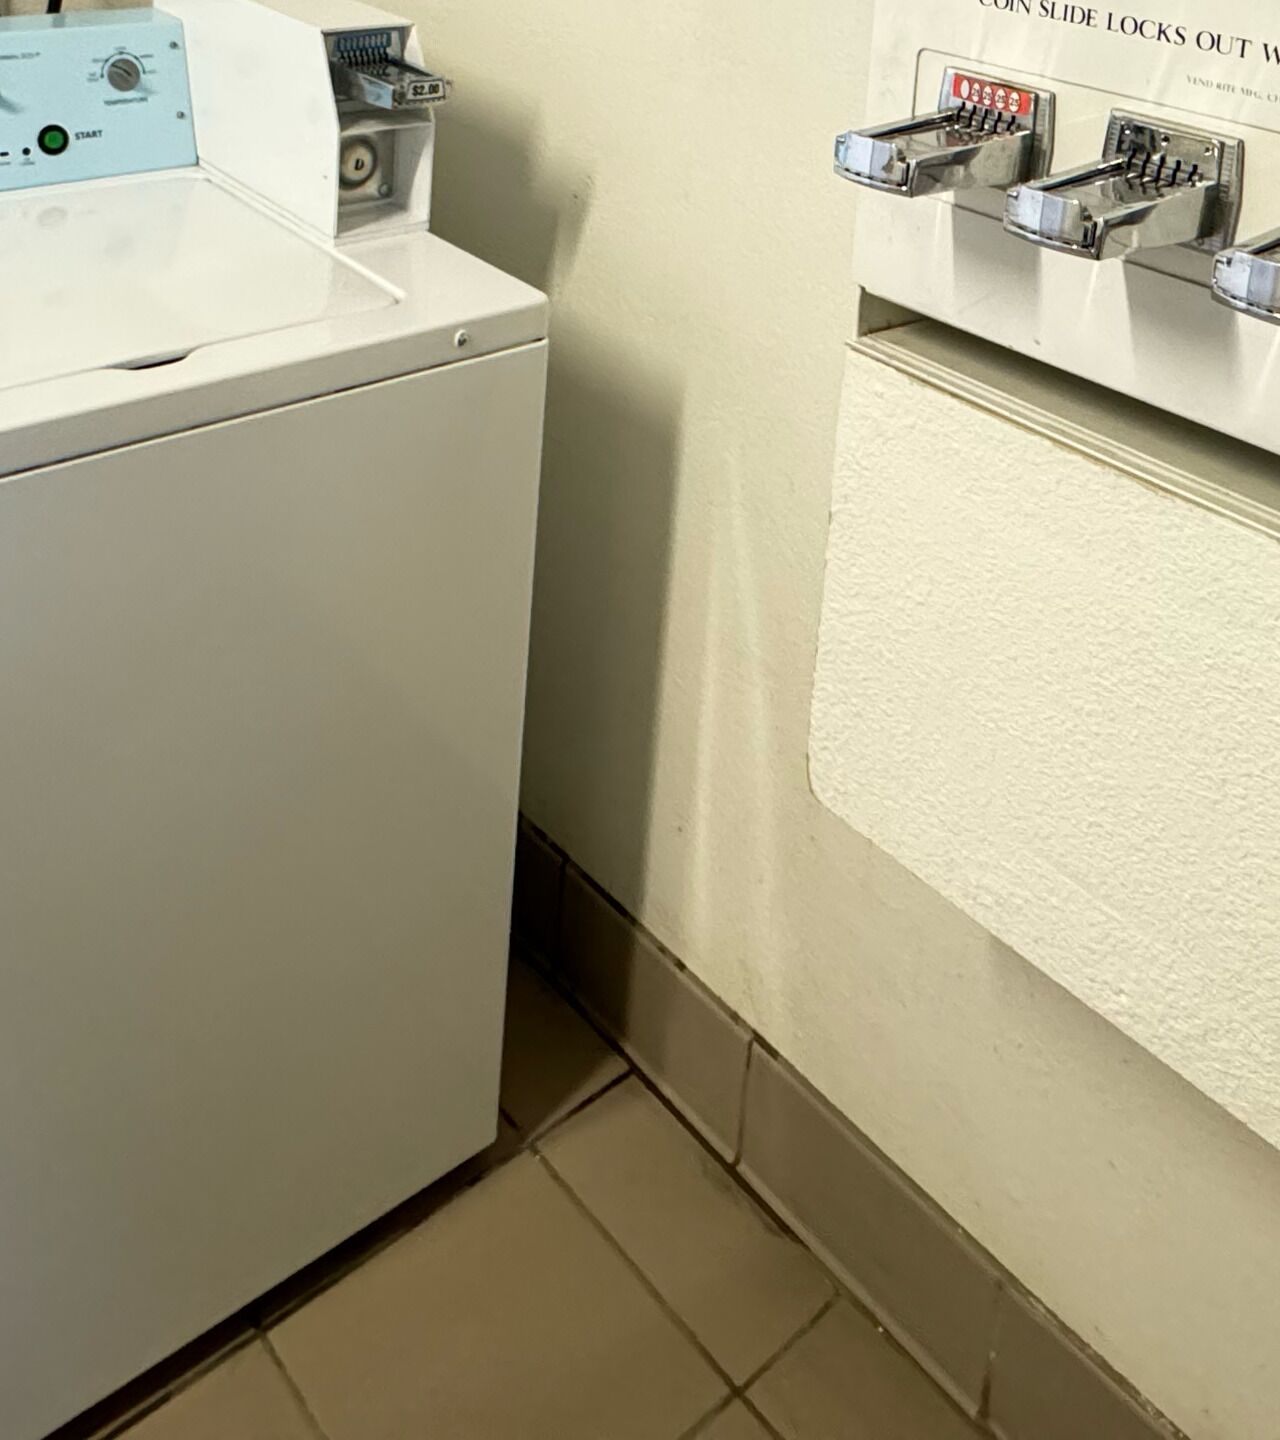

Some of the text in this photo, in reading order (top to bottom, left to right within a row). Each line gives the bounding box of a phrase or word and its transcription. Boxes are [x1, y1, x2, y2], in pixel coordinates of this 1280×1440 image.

[1106, 10, 1188, 47] LOCKS
[1195, 30, 1253, 59] OUT
[411, 83, 441, 97] $2.00
[1186, 74, 1214, 89] VEND
[1216, 81, 1236, 94] RITE
[75, 130, 103, 141] START
